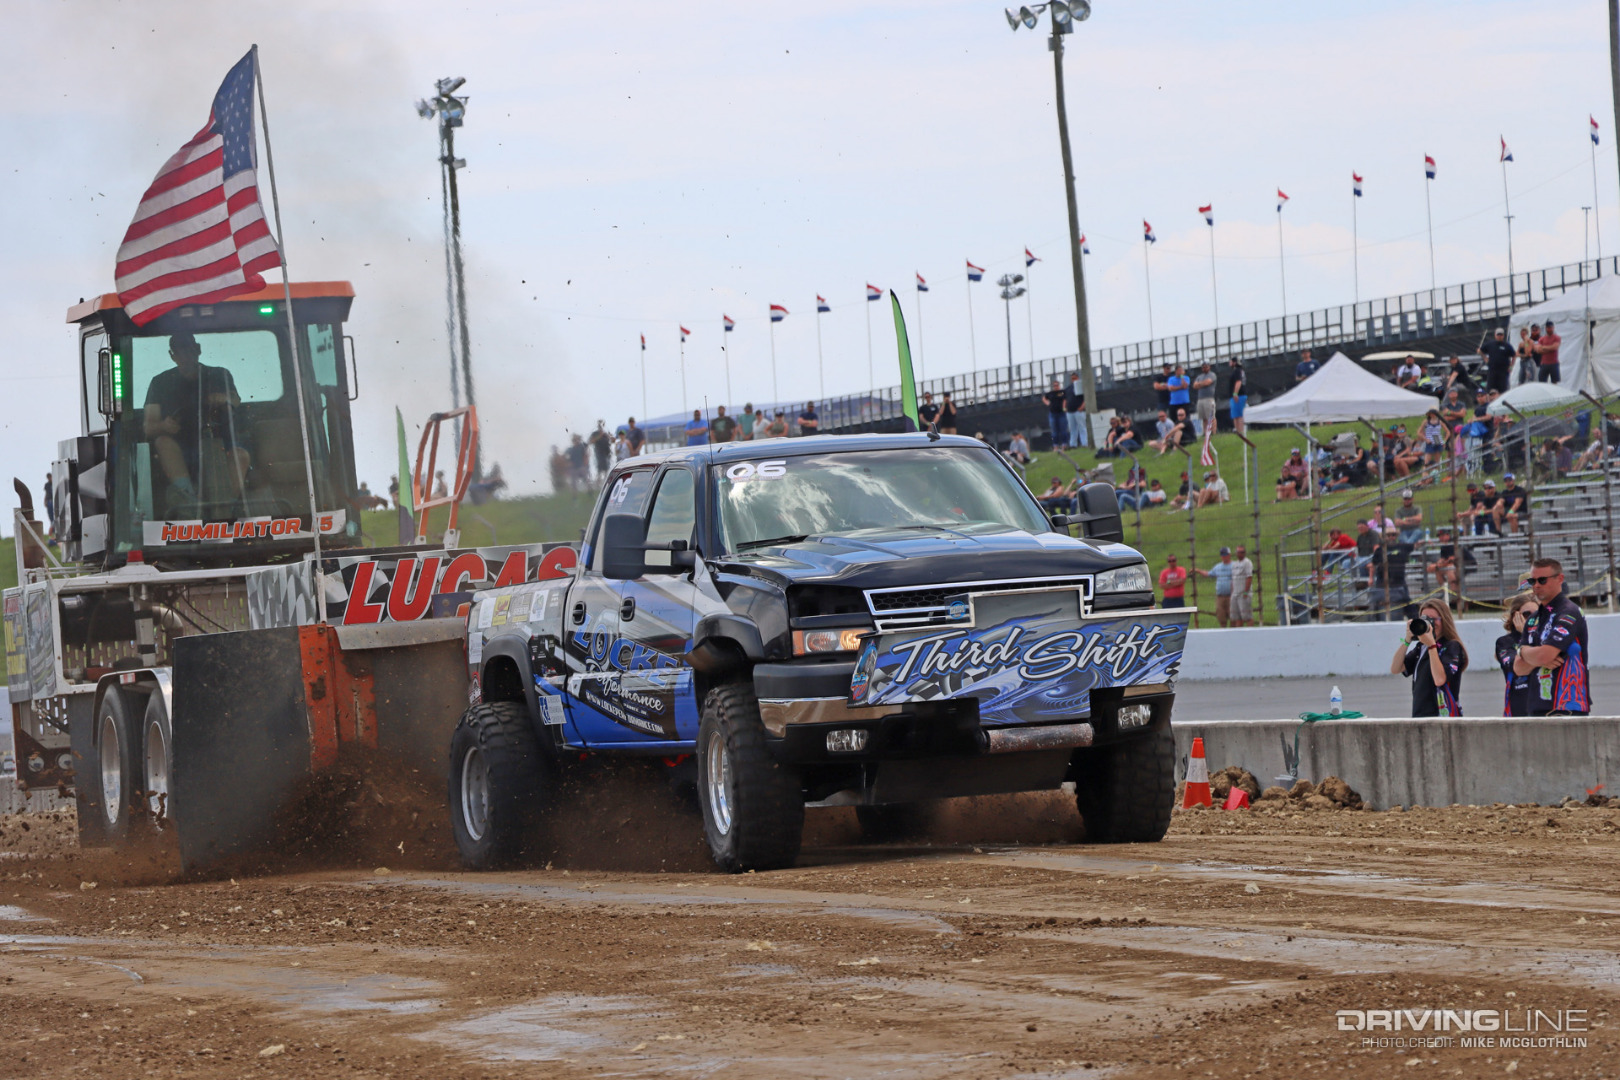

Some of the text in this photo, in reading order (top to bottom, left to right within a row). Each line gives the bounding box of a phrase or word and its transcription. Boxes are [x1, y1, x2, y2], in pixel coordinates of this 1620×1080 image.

[727, 461, 786, 478] 06
[611, 478, 632, 503] 06
[161, 518, 301, 541] HUMILIATOR
[342, 546, 579, 625] LUCAS
[891, 625, 1180, 683] Third Shift
[585, 690, 665, 734] WWW.LOCKEPERORMANCE.COM
